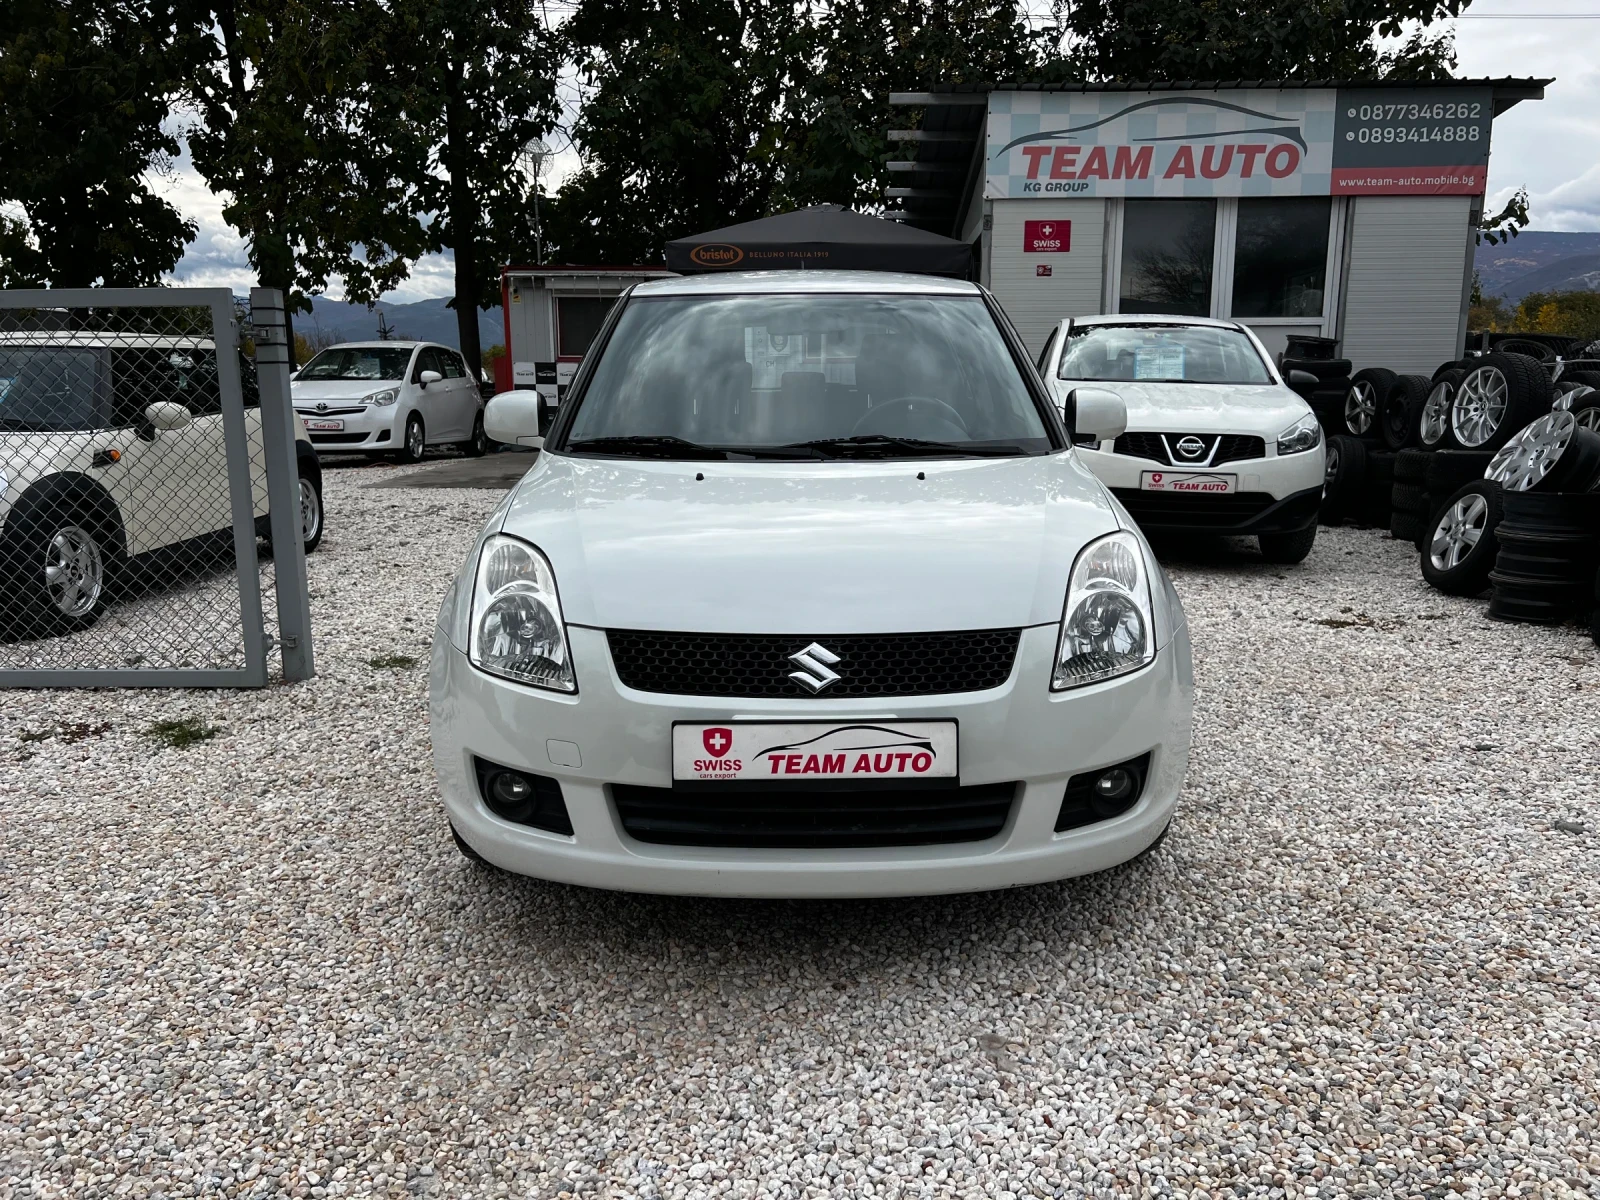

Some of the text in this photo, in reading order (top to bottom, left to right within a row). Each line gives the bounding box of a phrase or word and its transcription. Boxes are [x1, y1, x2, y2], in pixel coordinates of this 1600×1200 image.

[1360, 103, 1481, 120] 0877346262
[1358, 126, 1480, 143] 0893414888
[1022, 143, 1300, 180] TEAM AUTO
[1023, 182, 1089, 192] KG GROUP
[1339, 175, 1475, 187] www.team-auto.mobile.bg
[700, 248, 735, 260] bristot
[1173, 483, 1199, 491] TEAM
[693, 759, 742, 772] SWISS
[768, 752, 932, 774] TEAM AUTO
[714, 772, 737, 780] export
